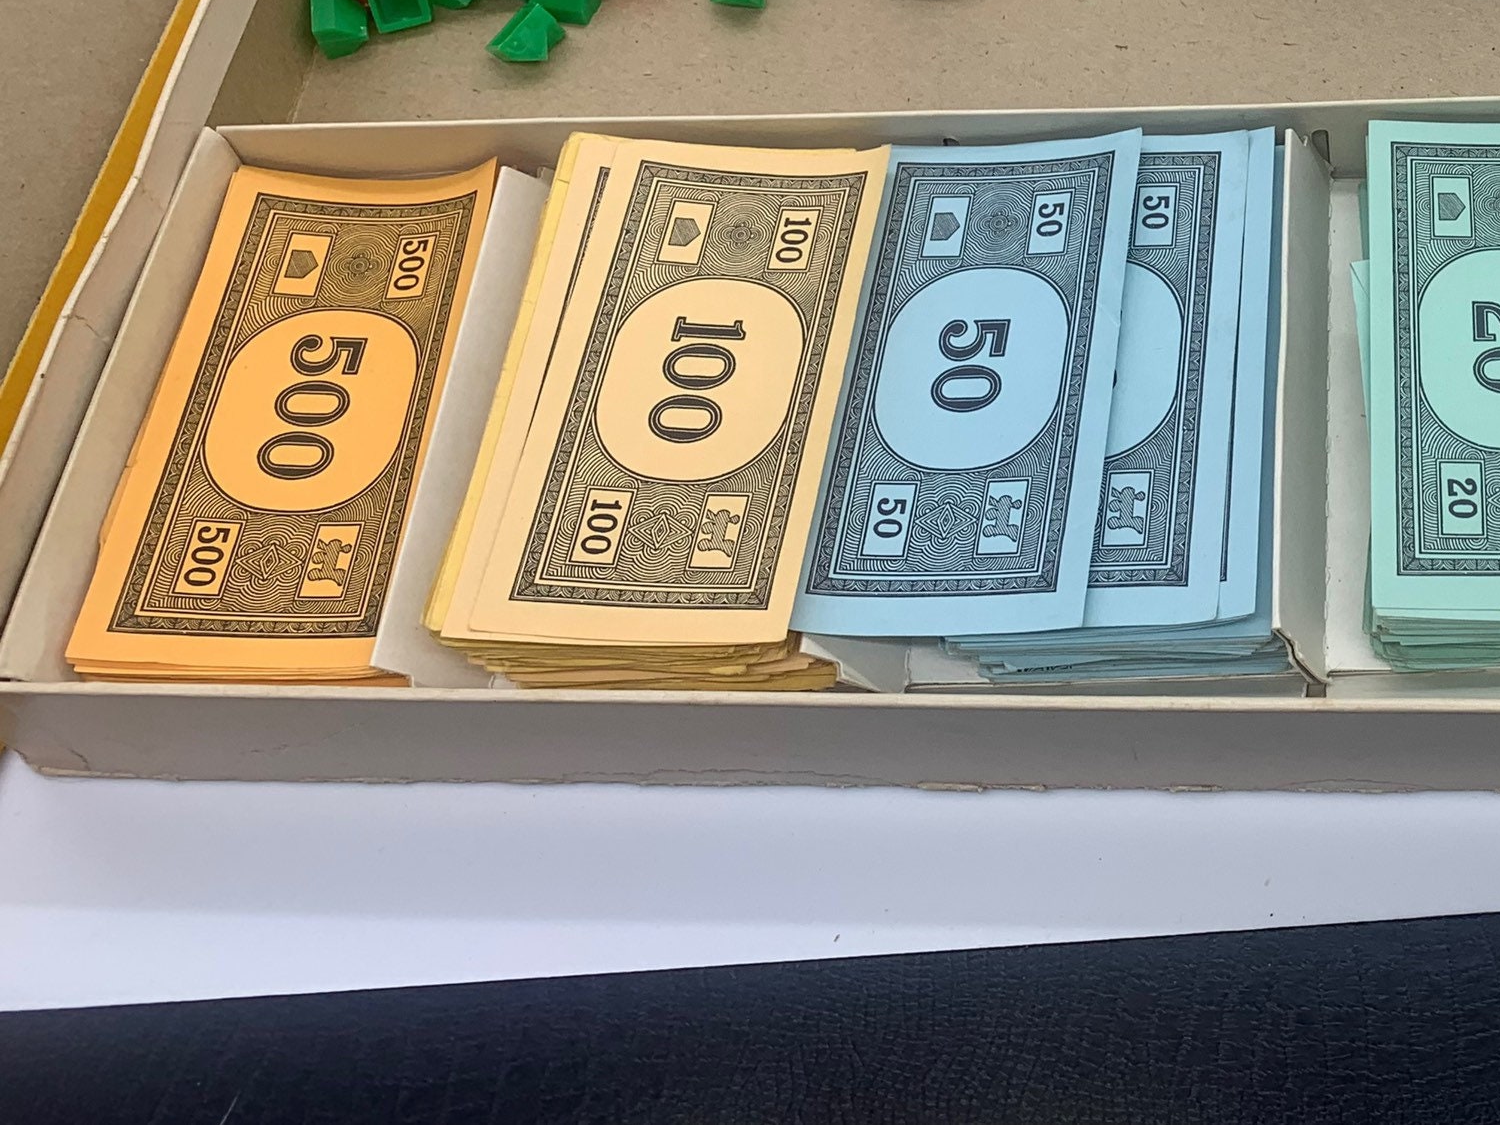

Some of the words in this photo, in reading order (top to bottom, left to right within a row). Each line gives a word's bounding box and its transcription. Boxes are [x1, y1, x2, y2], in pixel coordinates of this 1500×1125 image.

[1036, 201, 1065, 237] 50
[1141, 194, 1170, 229] 50
[393, 238, 429, 291] 500
[775, 216, 812, 264] 100
[648, 316, 747, 443] 100
[930, 318, 1011, 413] 50
[256, 334, 368, 480] 500
[873, 498, 906, 539] 50
[1447, 477, 1477, 519] 20
[581, 499, 621, 556] 100
[183, 526, 231, 588] 500
